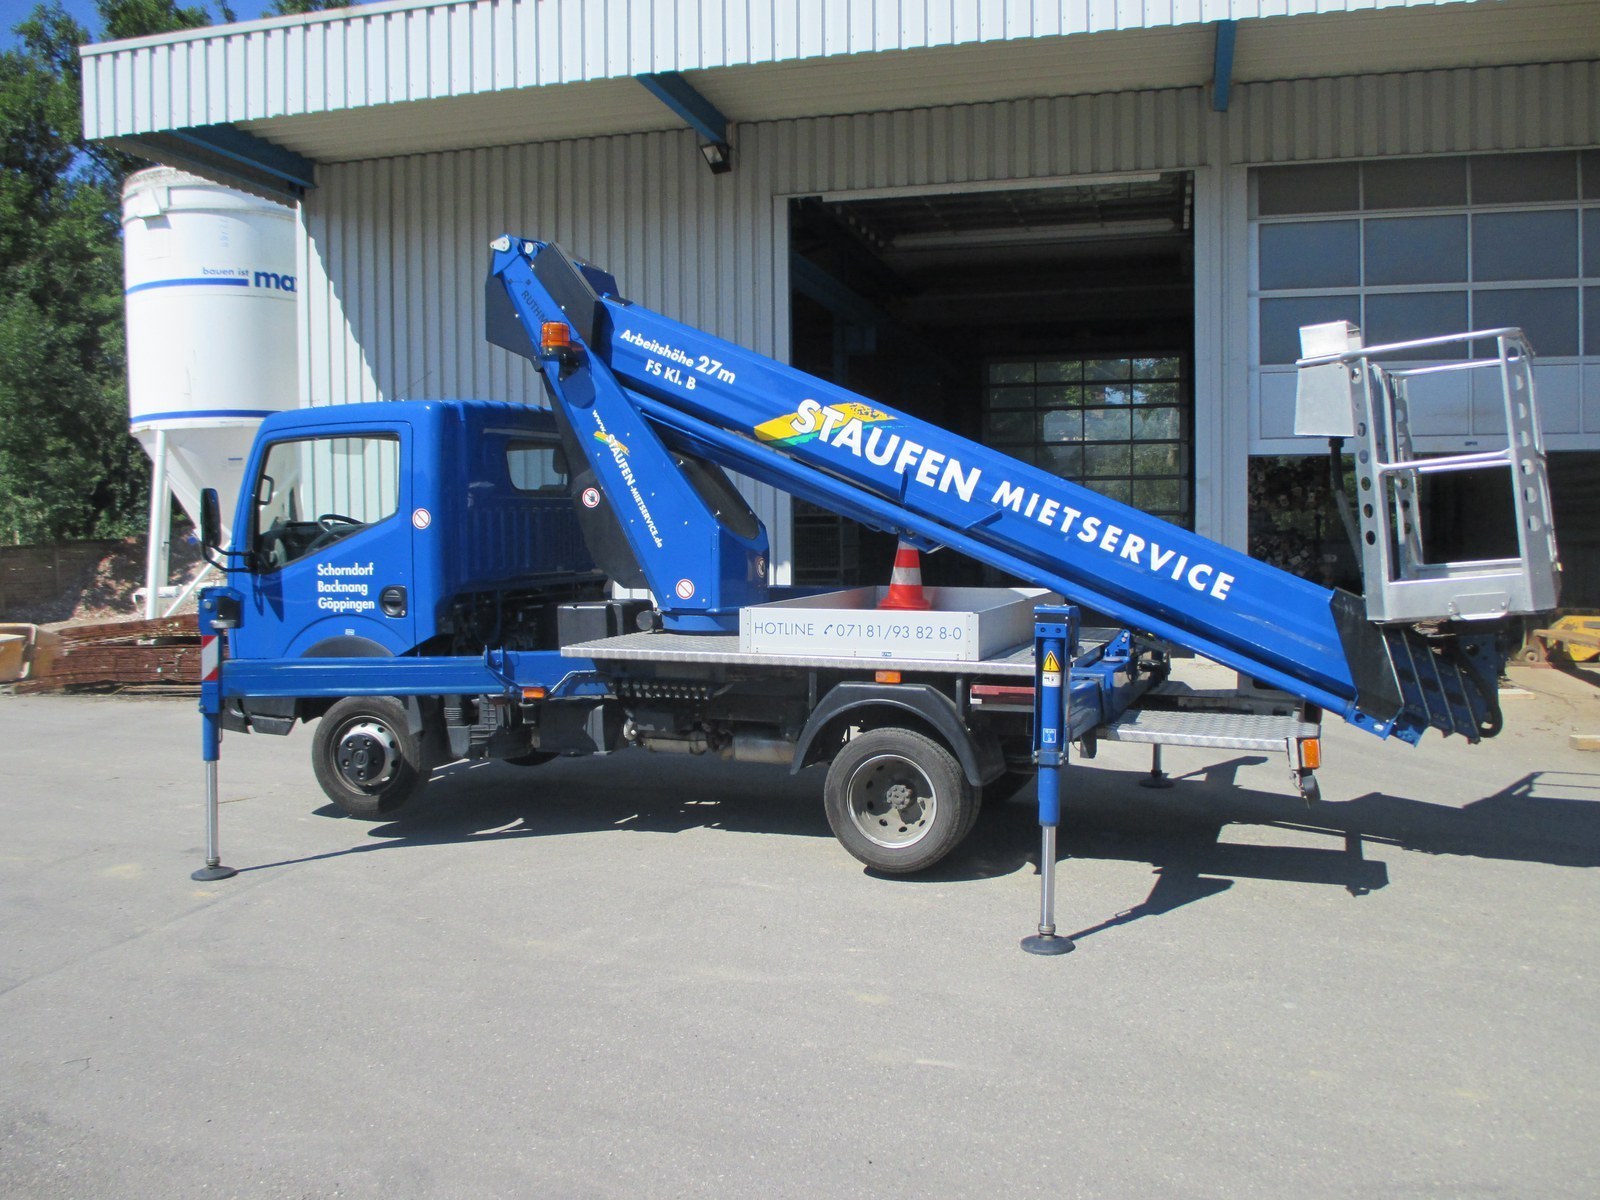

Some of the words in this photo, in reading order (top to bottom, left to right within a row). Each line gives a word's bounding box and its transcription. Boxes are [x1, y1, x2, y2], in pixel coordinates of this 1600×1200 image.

[203, 266, 234, 276] bauen
[238, 267, 249, 276] ist
[253, 271, 298, 292] ma
[620, 329, 694, 367] Arbeitshöhe
[695, 355, 736, 384] 27m
[644, 358, 663, 376] FS
[663, 366, 682, 386] Kl.
[685, 375, 697, 390] B
[790, 398, 982, 502] STAUFEN
[991, 480, 1235, 600] MIETSERVICE
[317, 562, 374, 576] Schorndorf
[317, 579, 368, 596] Backnang
[317, 597, 375, 613] Göppingen
[754, 622, 814, 636] HOTLINE
[836, 623, 910, 640] 07181/93
[916, 626, 933, 640] 82
[939, 626, 962, 640] 8-0
